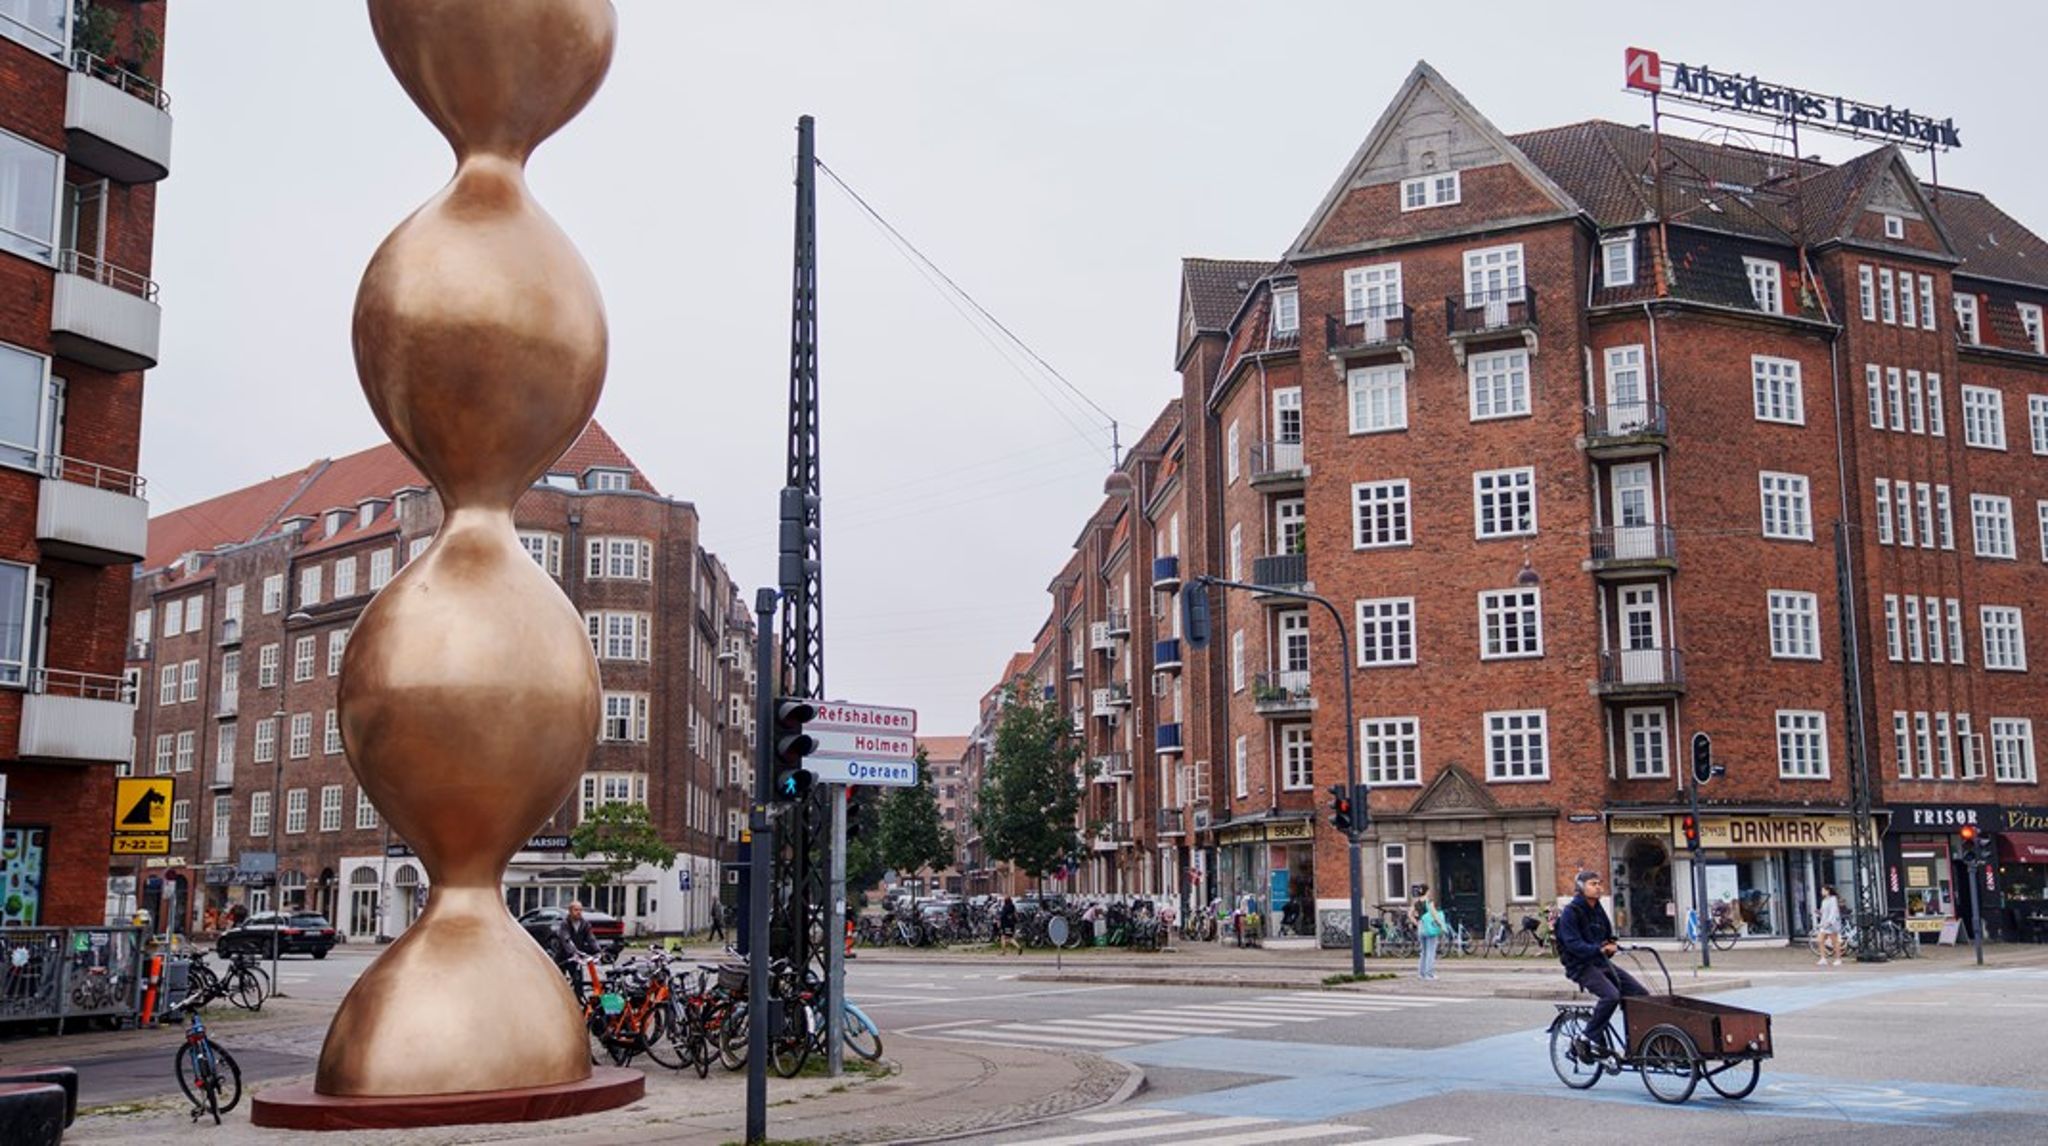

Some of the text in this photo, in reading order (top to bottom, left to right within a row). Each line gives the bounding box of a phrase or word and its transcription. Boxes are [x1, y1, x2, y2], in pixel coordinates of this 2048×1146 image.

[1674, 62, 1827, 120] Arbejdernes
[1836, 97, 1962, 149] Landsbank
[818, 705, 909, 727] Refshaleøen
[855, 735, 909, 753] Holmen
[849, 762, 909, 780] Operaen
[1730, 820, 1827, 844] DANMARK
[118, 840, 147, 850] 7-22
